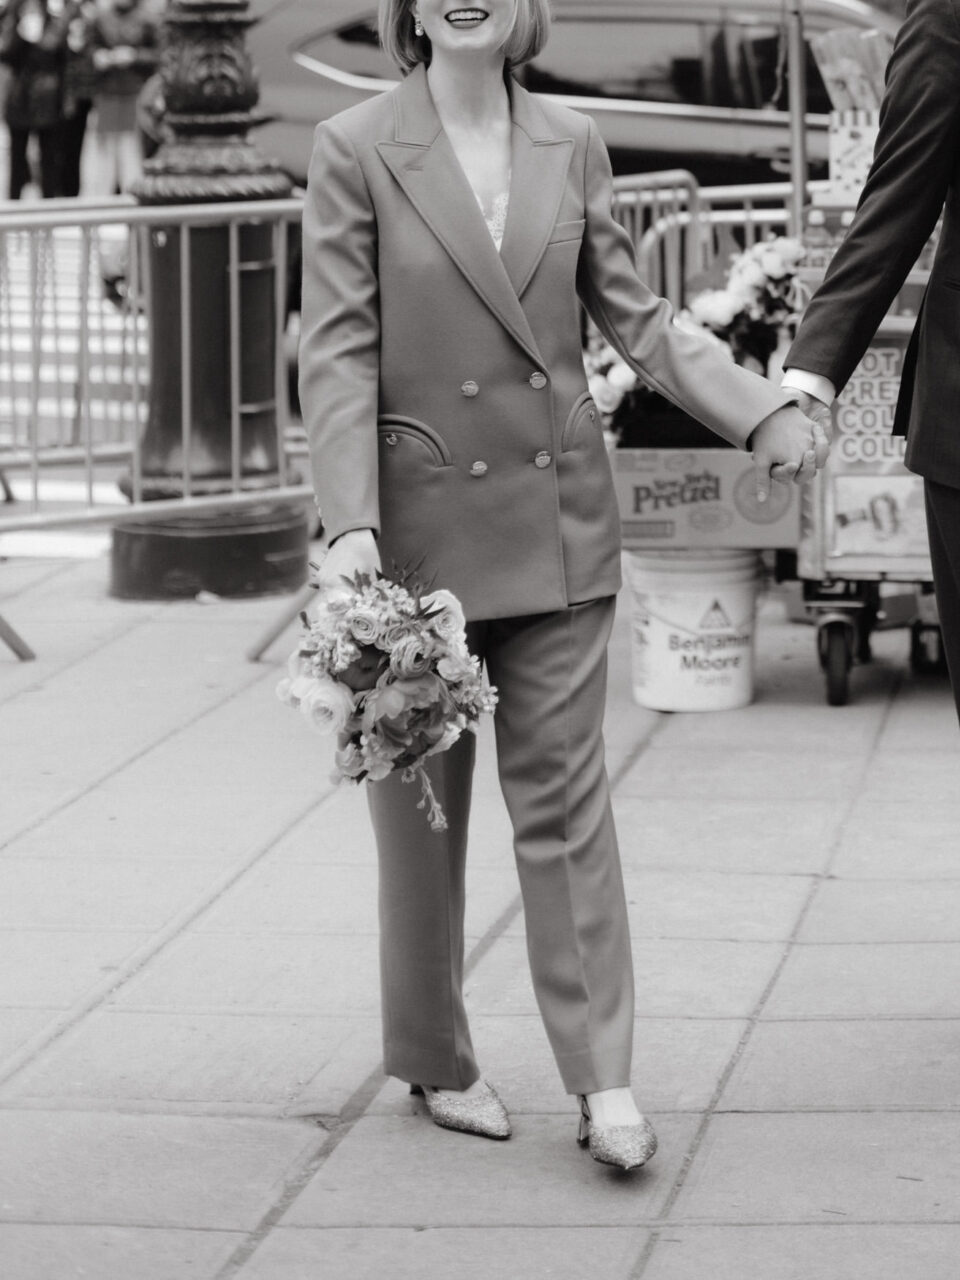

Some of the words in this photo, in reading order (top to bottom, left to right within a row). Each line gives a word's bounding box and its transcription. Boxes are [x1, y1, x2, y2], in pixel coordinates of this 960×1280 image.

[862, 352, 896, 373] OT
[843, 411, 894, 430] COL
[632, 477, 721, 515] Pretzel
[681, 655, 742, 670] Moore
